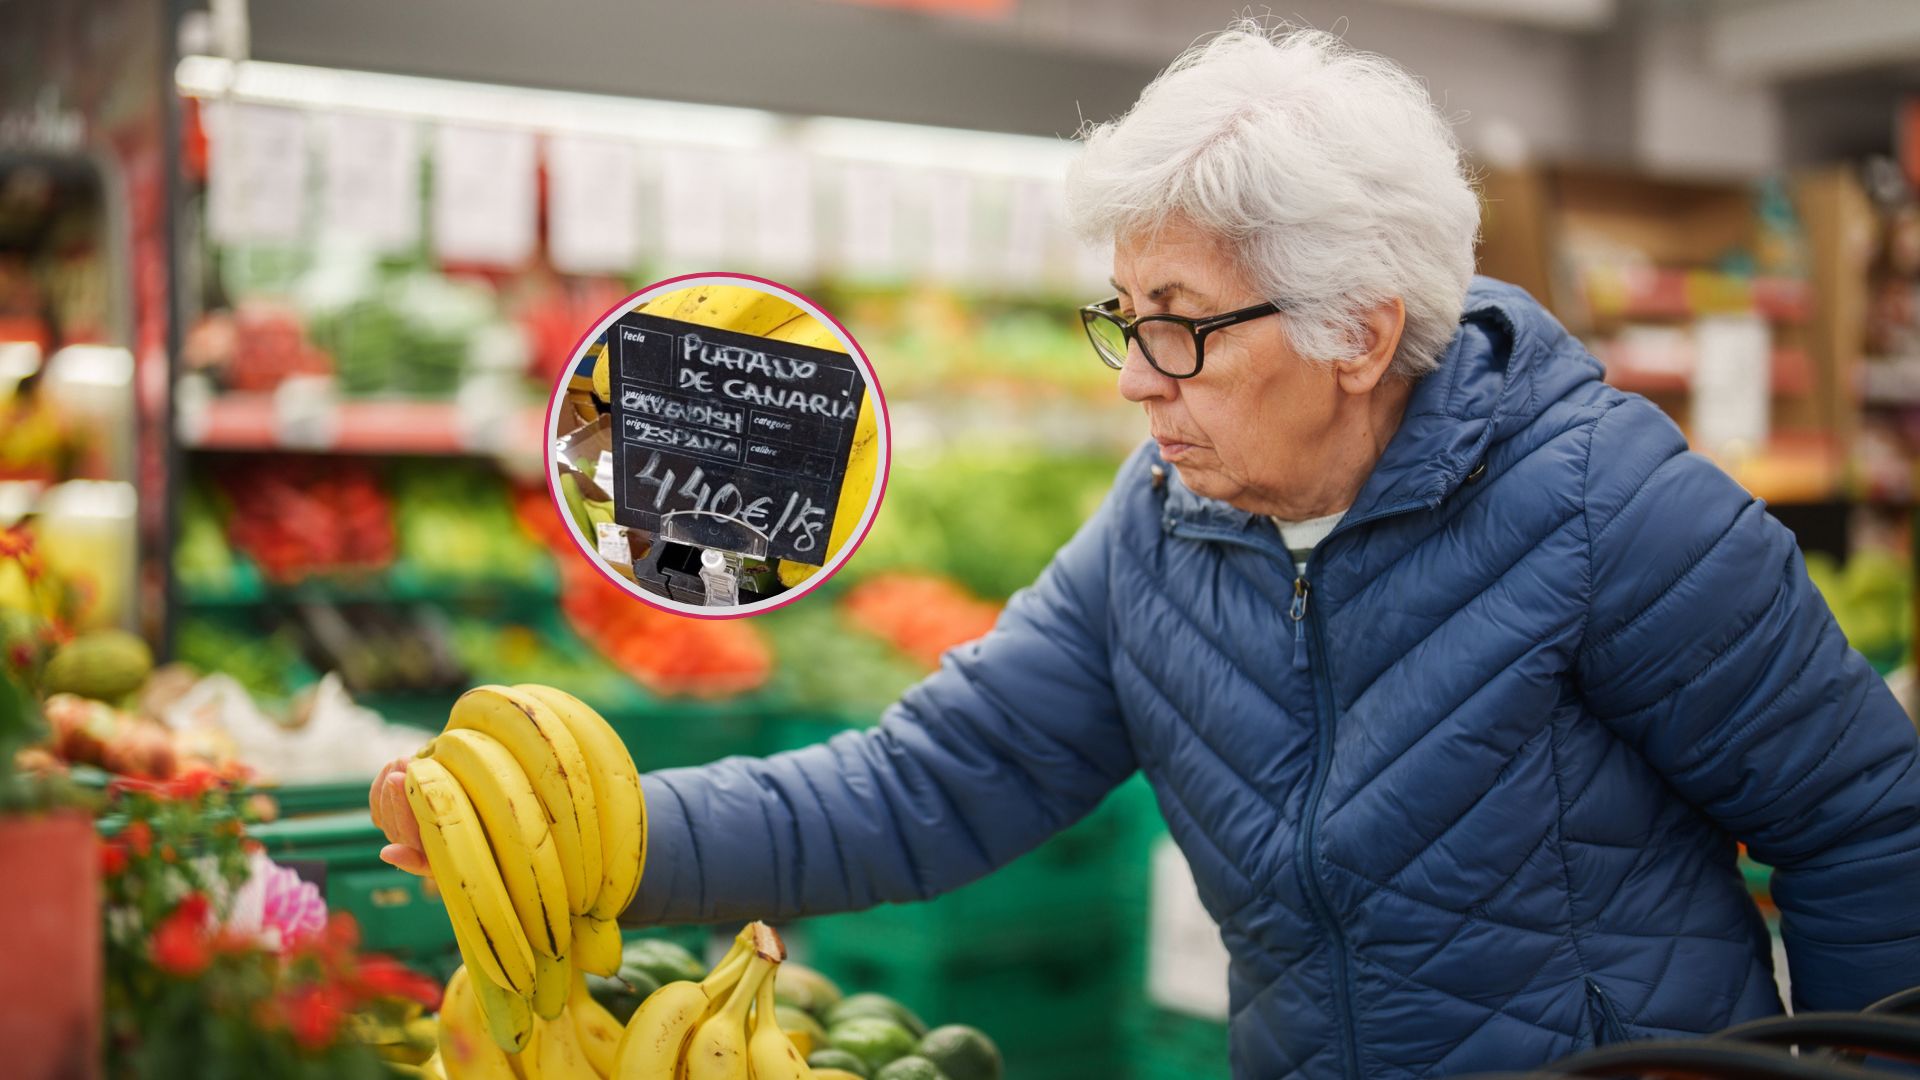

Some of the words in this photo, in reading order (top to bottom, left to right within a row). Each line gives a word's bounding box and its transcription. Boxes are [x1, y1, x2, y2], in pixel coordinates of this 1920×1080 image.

[623, 330, 645, 343] tecla
[679, 368, 713, 393] DE
[621, 397, 741, 433] CAVENDISH
[626, 418, 651, 430] origen
[750, 444, 778, 456] calibre
